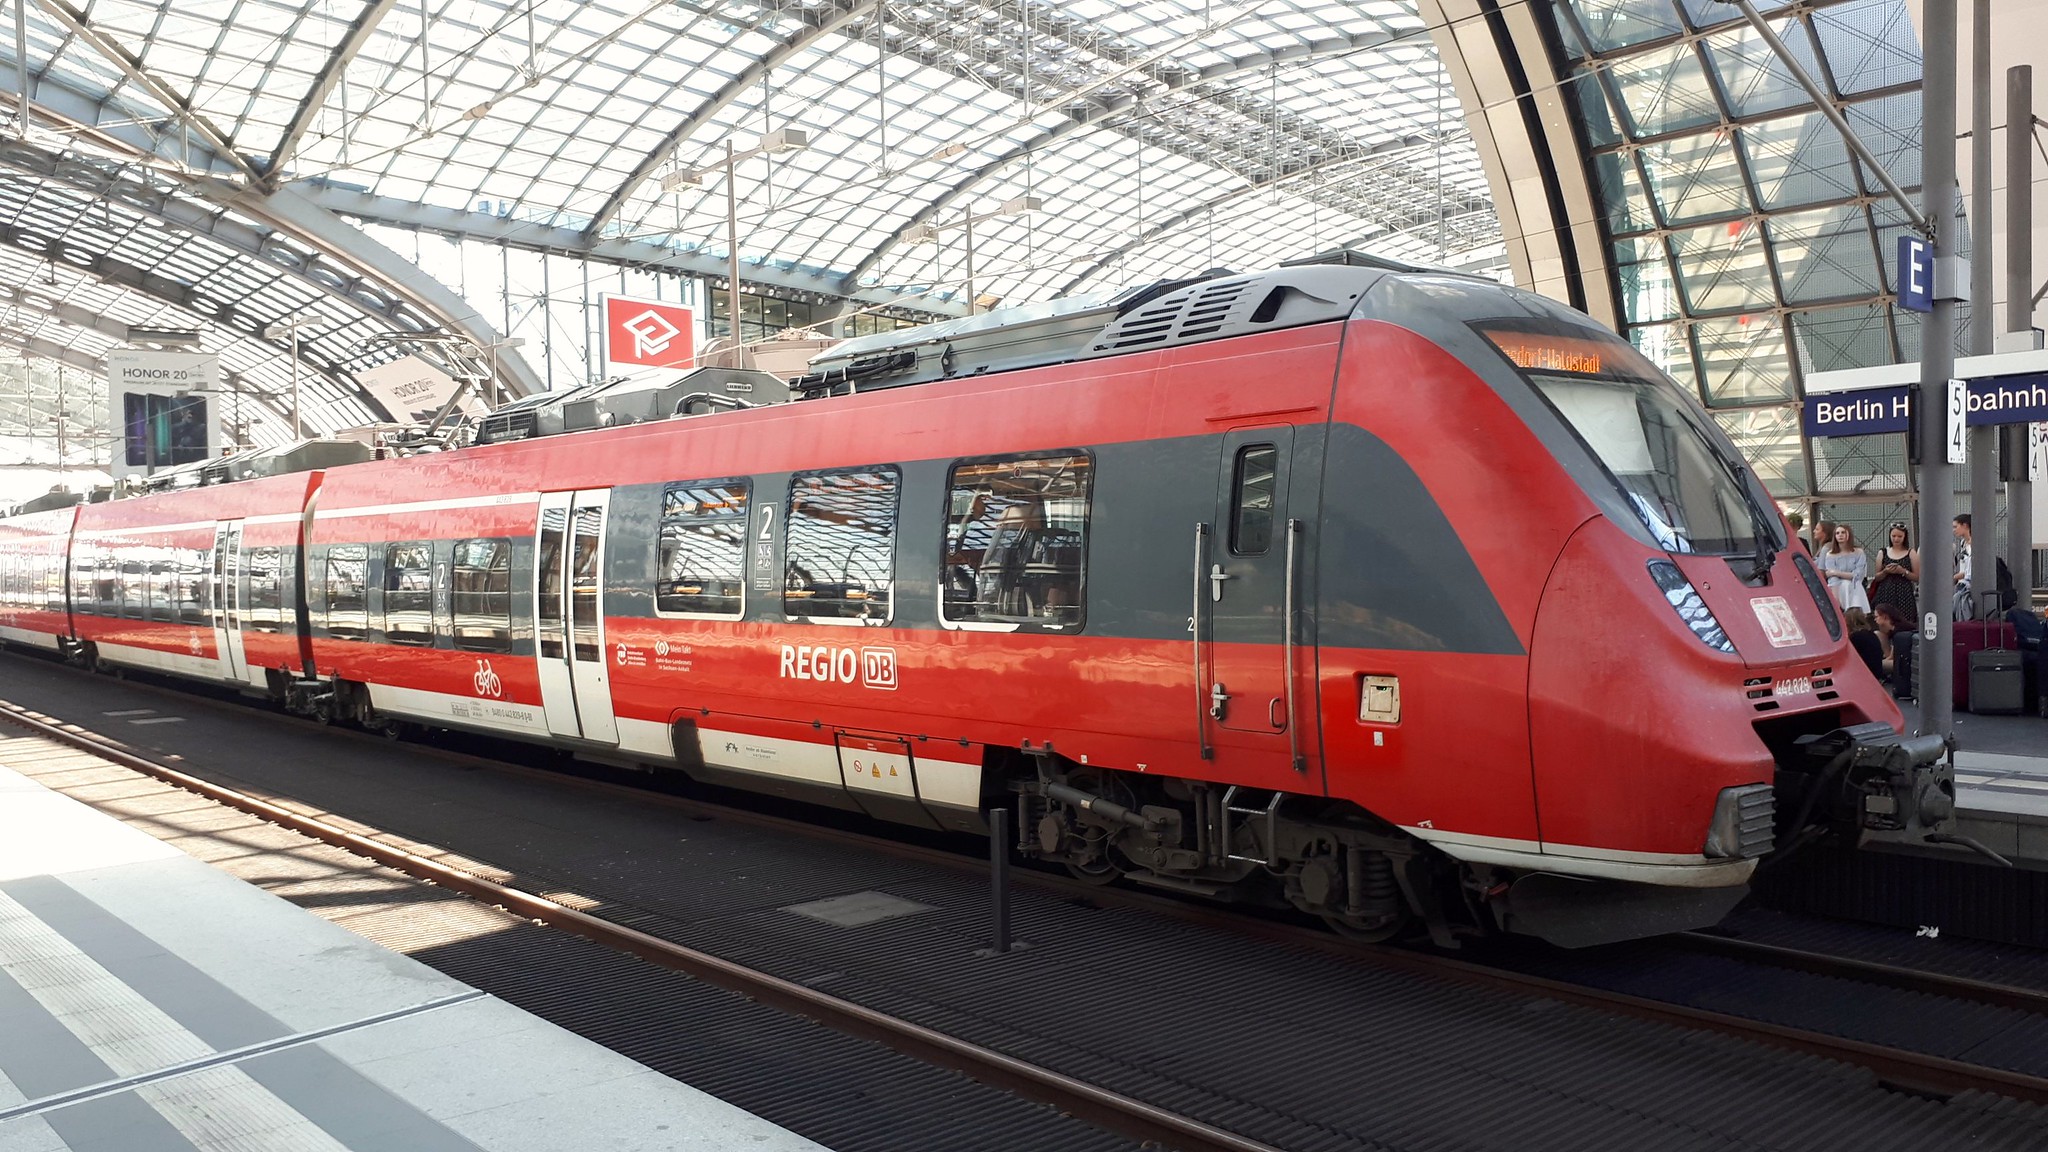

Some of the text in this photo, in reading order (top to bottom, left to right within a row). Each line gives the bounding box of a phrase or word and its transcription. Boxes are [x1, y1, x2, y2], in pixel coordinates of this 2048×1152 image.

[1911, 241, 1923, 294] E
[123, 368, 170, 379] HONOR
[173, 370, 188, 380] 20
[1816, 384, 2047, 424] Berlin H bahnh
[1953, 386, 1961, 416] 5
[1953, 421, 1961, 452] 4
[759, 505, 773, 540] 2
[437, 563, 445, 589] 2
[1187, 616, 1195, 631] 2
[1754, 601, 1802, 641] DB
[780, 645, 895, 686] REGIO DB
